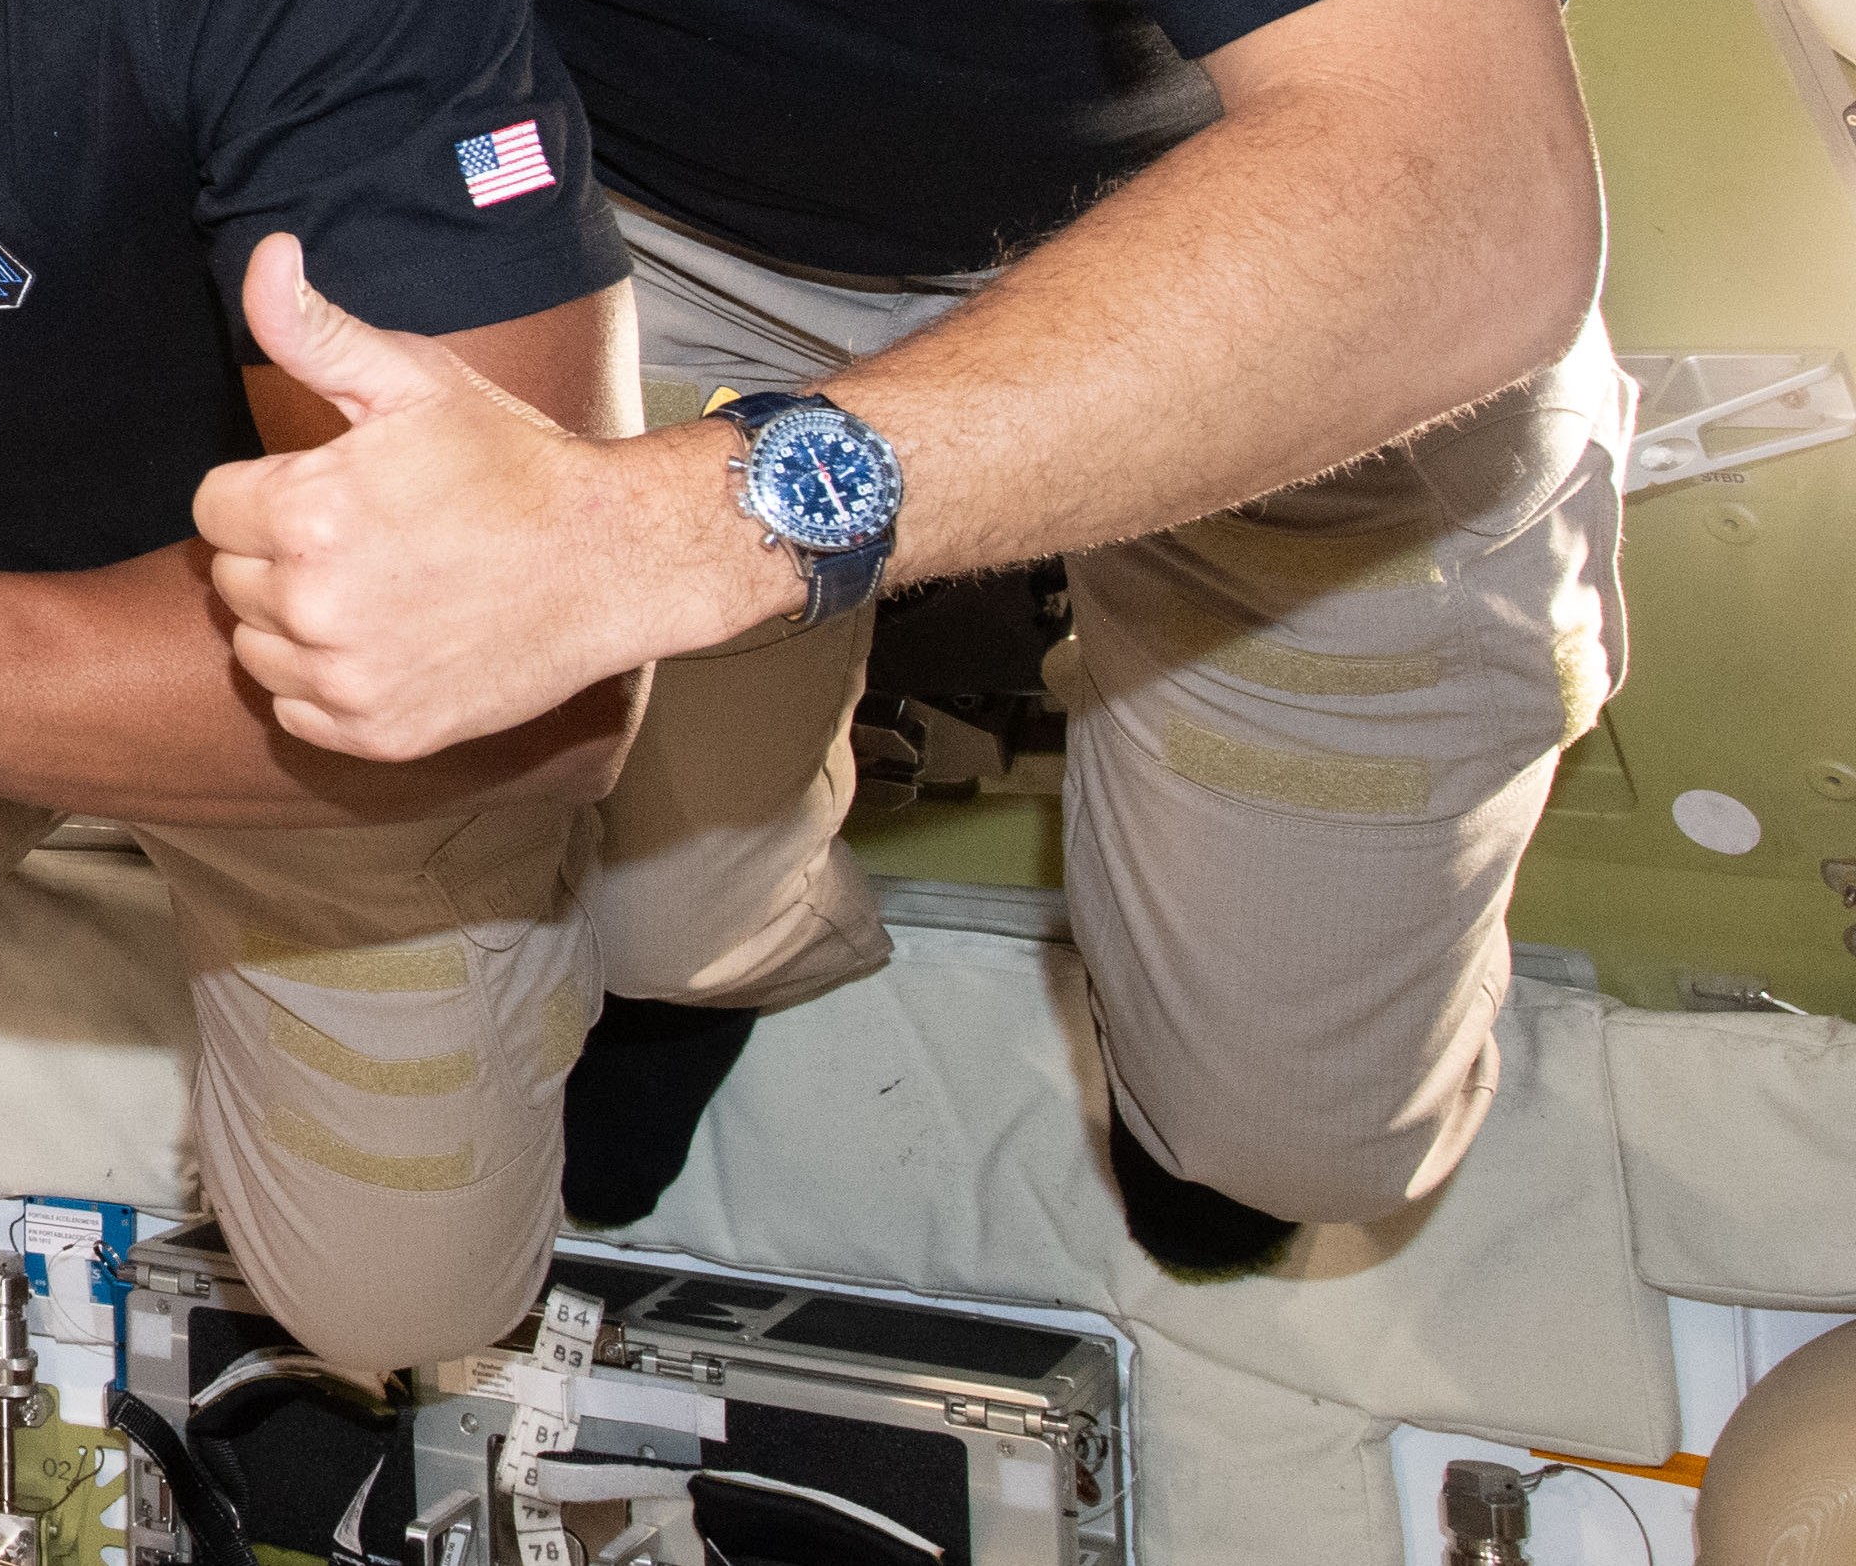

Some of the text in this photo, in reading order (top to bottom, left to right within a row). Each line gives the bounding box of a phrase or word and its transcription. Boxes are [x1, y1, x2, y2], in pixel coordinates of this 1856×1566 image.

[28, 1211, 55, 1223] PORTABLE
[557, 1304, 591, 1328] 84
[553, 1344, 583, 1368] 83
[536, 1426, 560, 1449] 81
[524, 1468, 538, 1487] 8
[529, 1541, 559, 1561] 78
